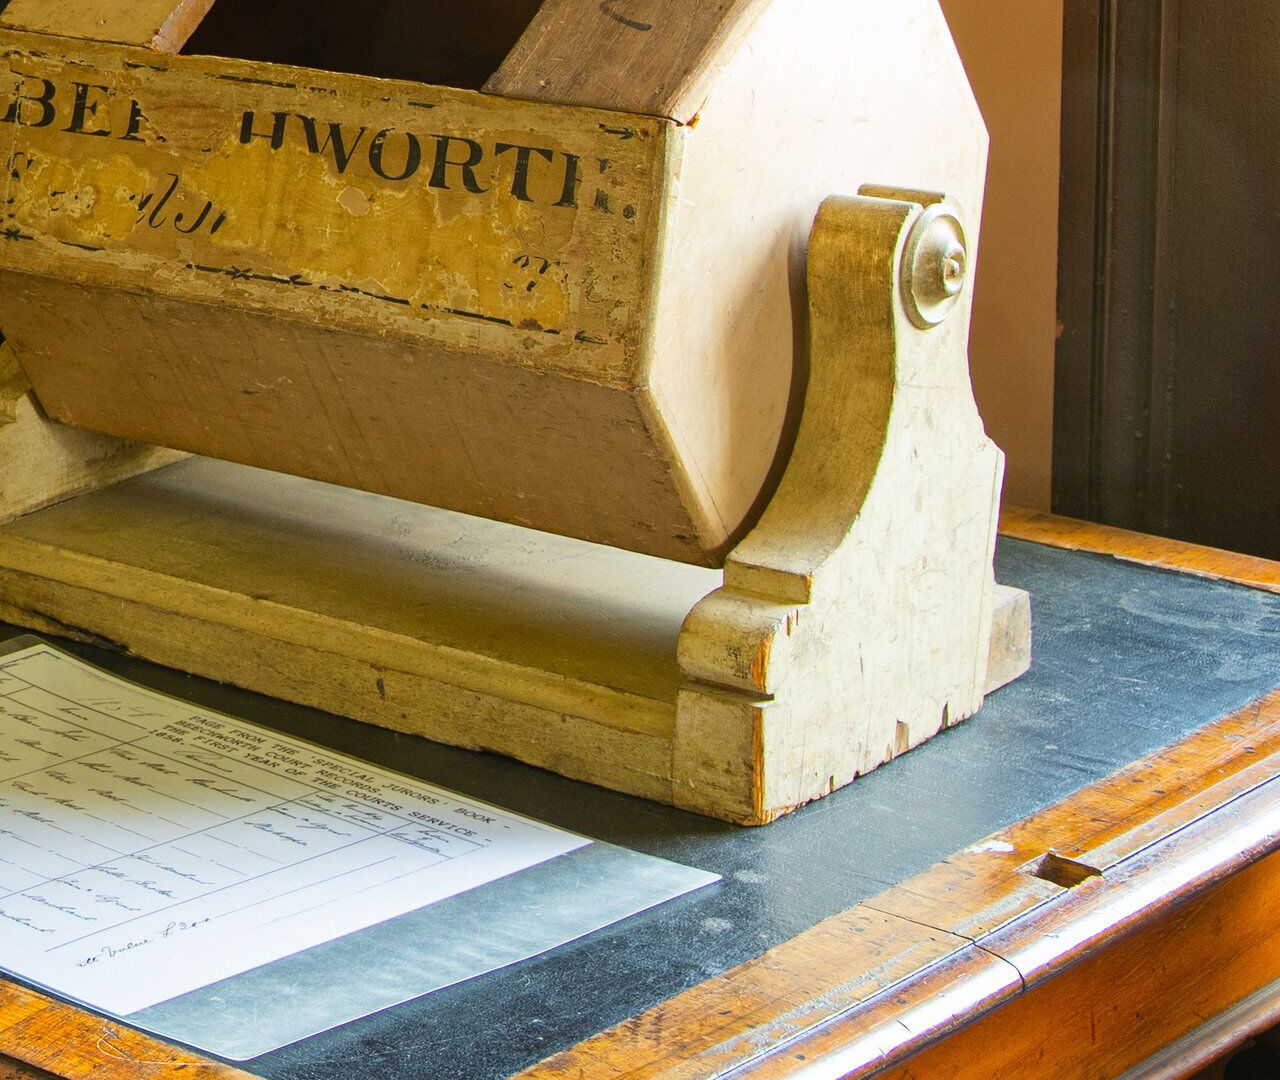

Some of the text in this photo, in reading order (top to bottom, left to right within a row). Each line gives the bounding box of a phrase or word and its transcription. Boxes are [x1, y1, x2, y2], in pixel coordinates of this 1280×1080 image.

[148, 729, 184, 745] 1858.
[162, 724, 190, 736] THE
[193, 736, 239, 753] FIRST
[244, 753, 281, 768] YEAR
[284, 768, 307, 776] OF
[311, 777, 342, 790] THE
[346, 790, 403, 811] COURTS
[408, 812, 477, 837] SERVICE
[174, 720, 261, 752] BEECHWORTH
[264, 752, 312, 769] COURT
[315, 769, 382, 796] RECORDS.
[188, 716, 226, 730] PAGE
[228, 729, 267, 744] FROM
[270, 744, 300, 756] THE
[454, 808, 496, 824] BOOK
